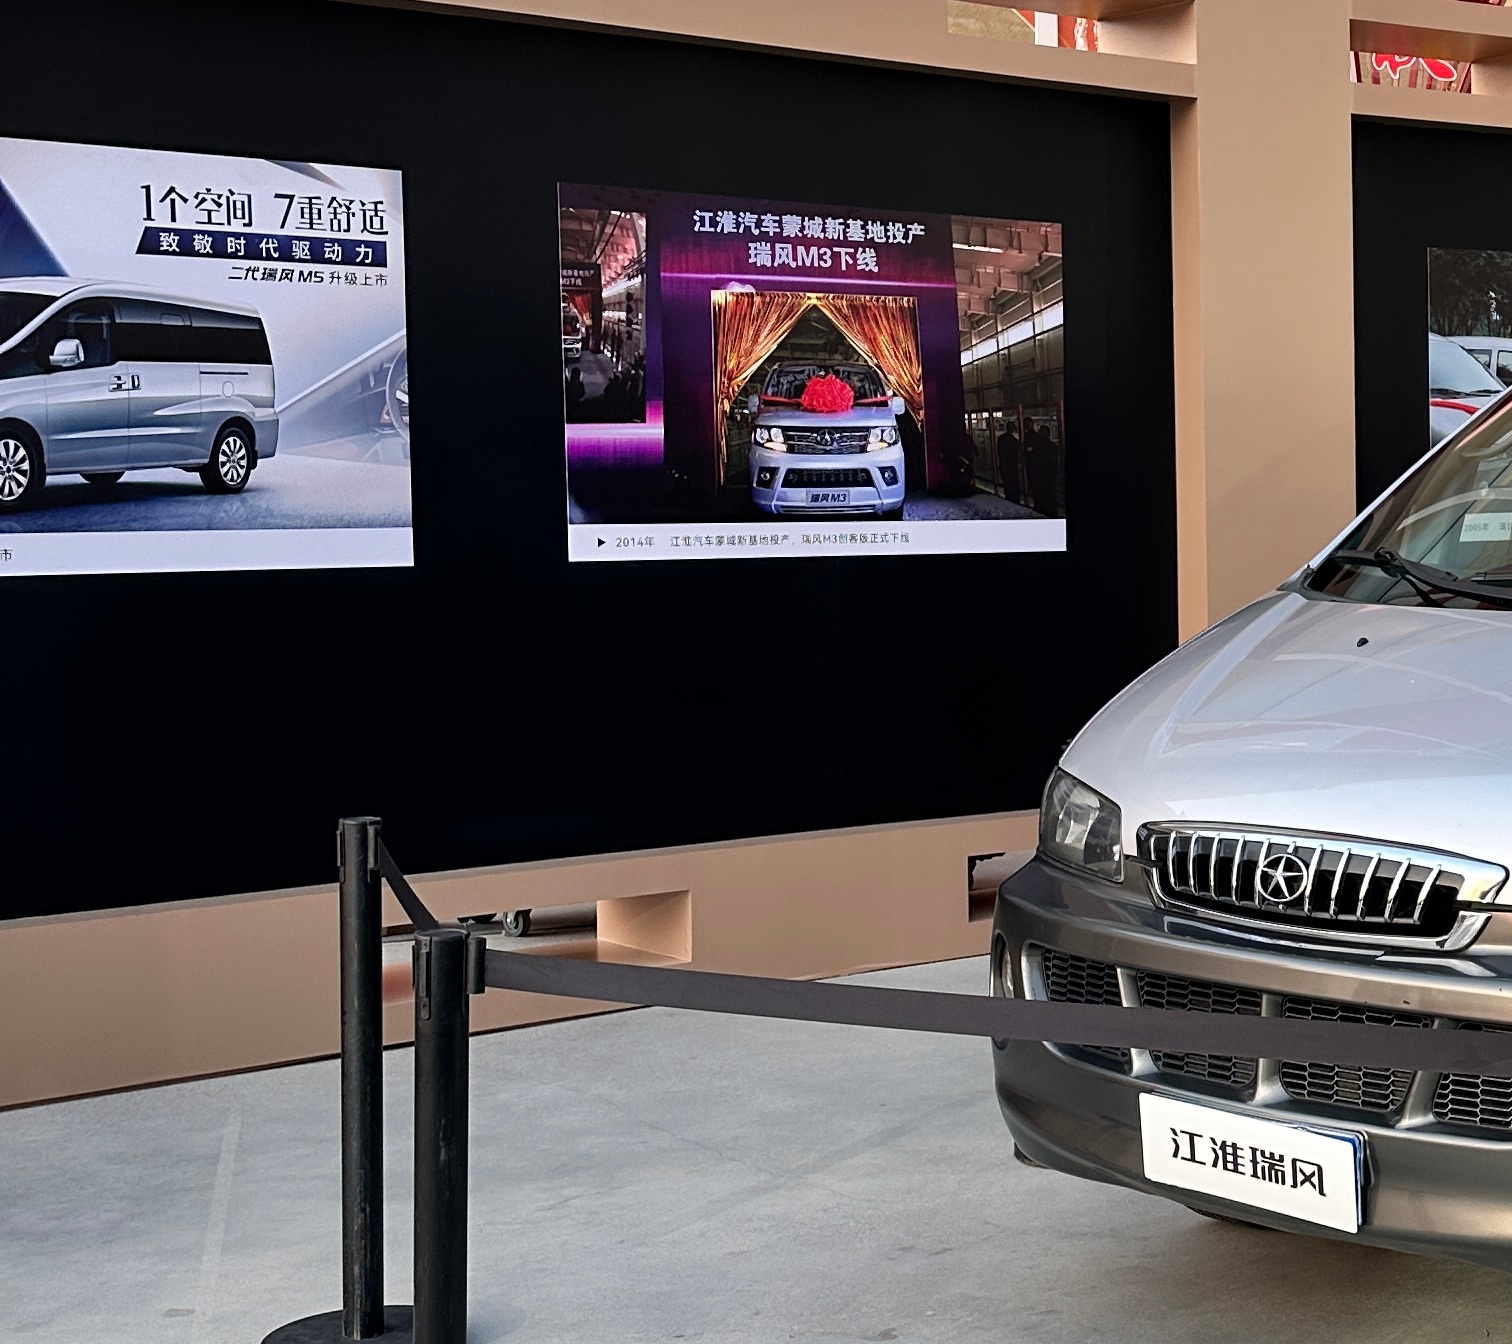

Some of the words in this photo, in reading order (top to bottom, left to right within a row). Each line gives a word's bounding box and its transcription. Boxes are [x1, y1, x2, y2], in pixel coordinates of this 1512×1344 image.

[140, 184, 253, 227] 1个空间
[274, 193, 389, 235] 7重舒适
[692, 209, 926, 245] 江淮汽车蒙城新基地投产
[158, 232, 374, 264] 致敬时代驱动力
[748, 242, 879, 273] 瑞风M3下线
[615, 536, 655, 547] 2014年
[1170, 1127, 1327, 1197] 江淮瑞风
